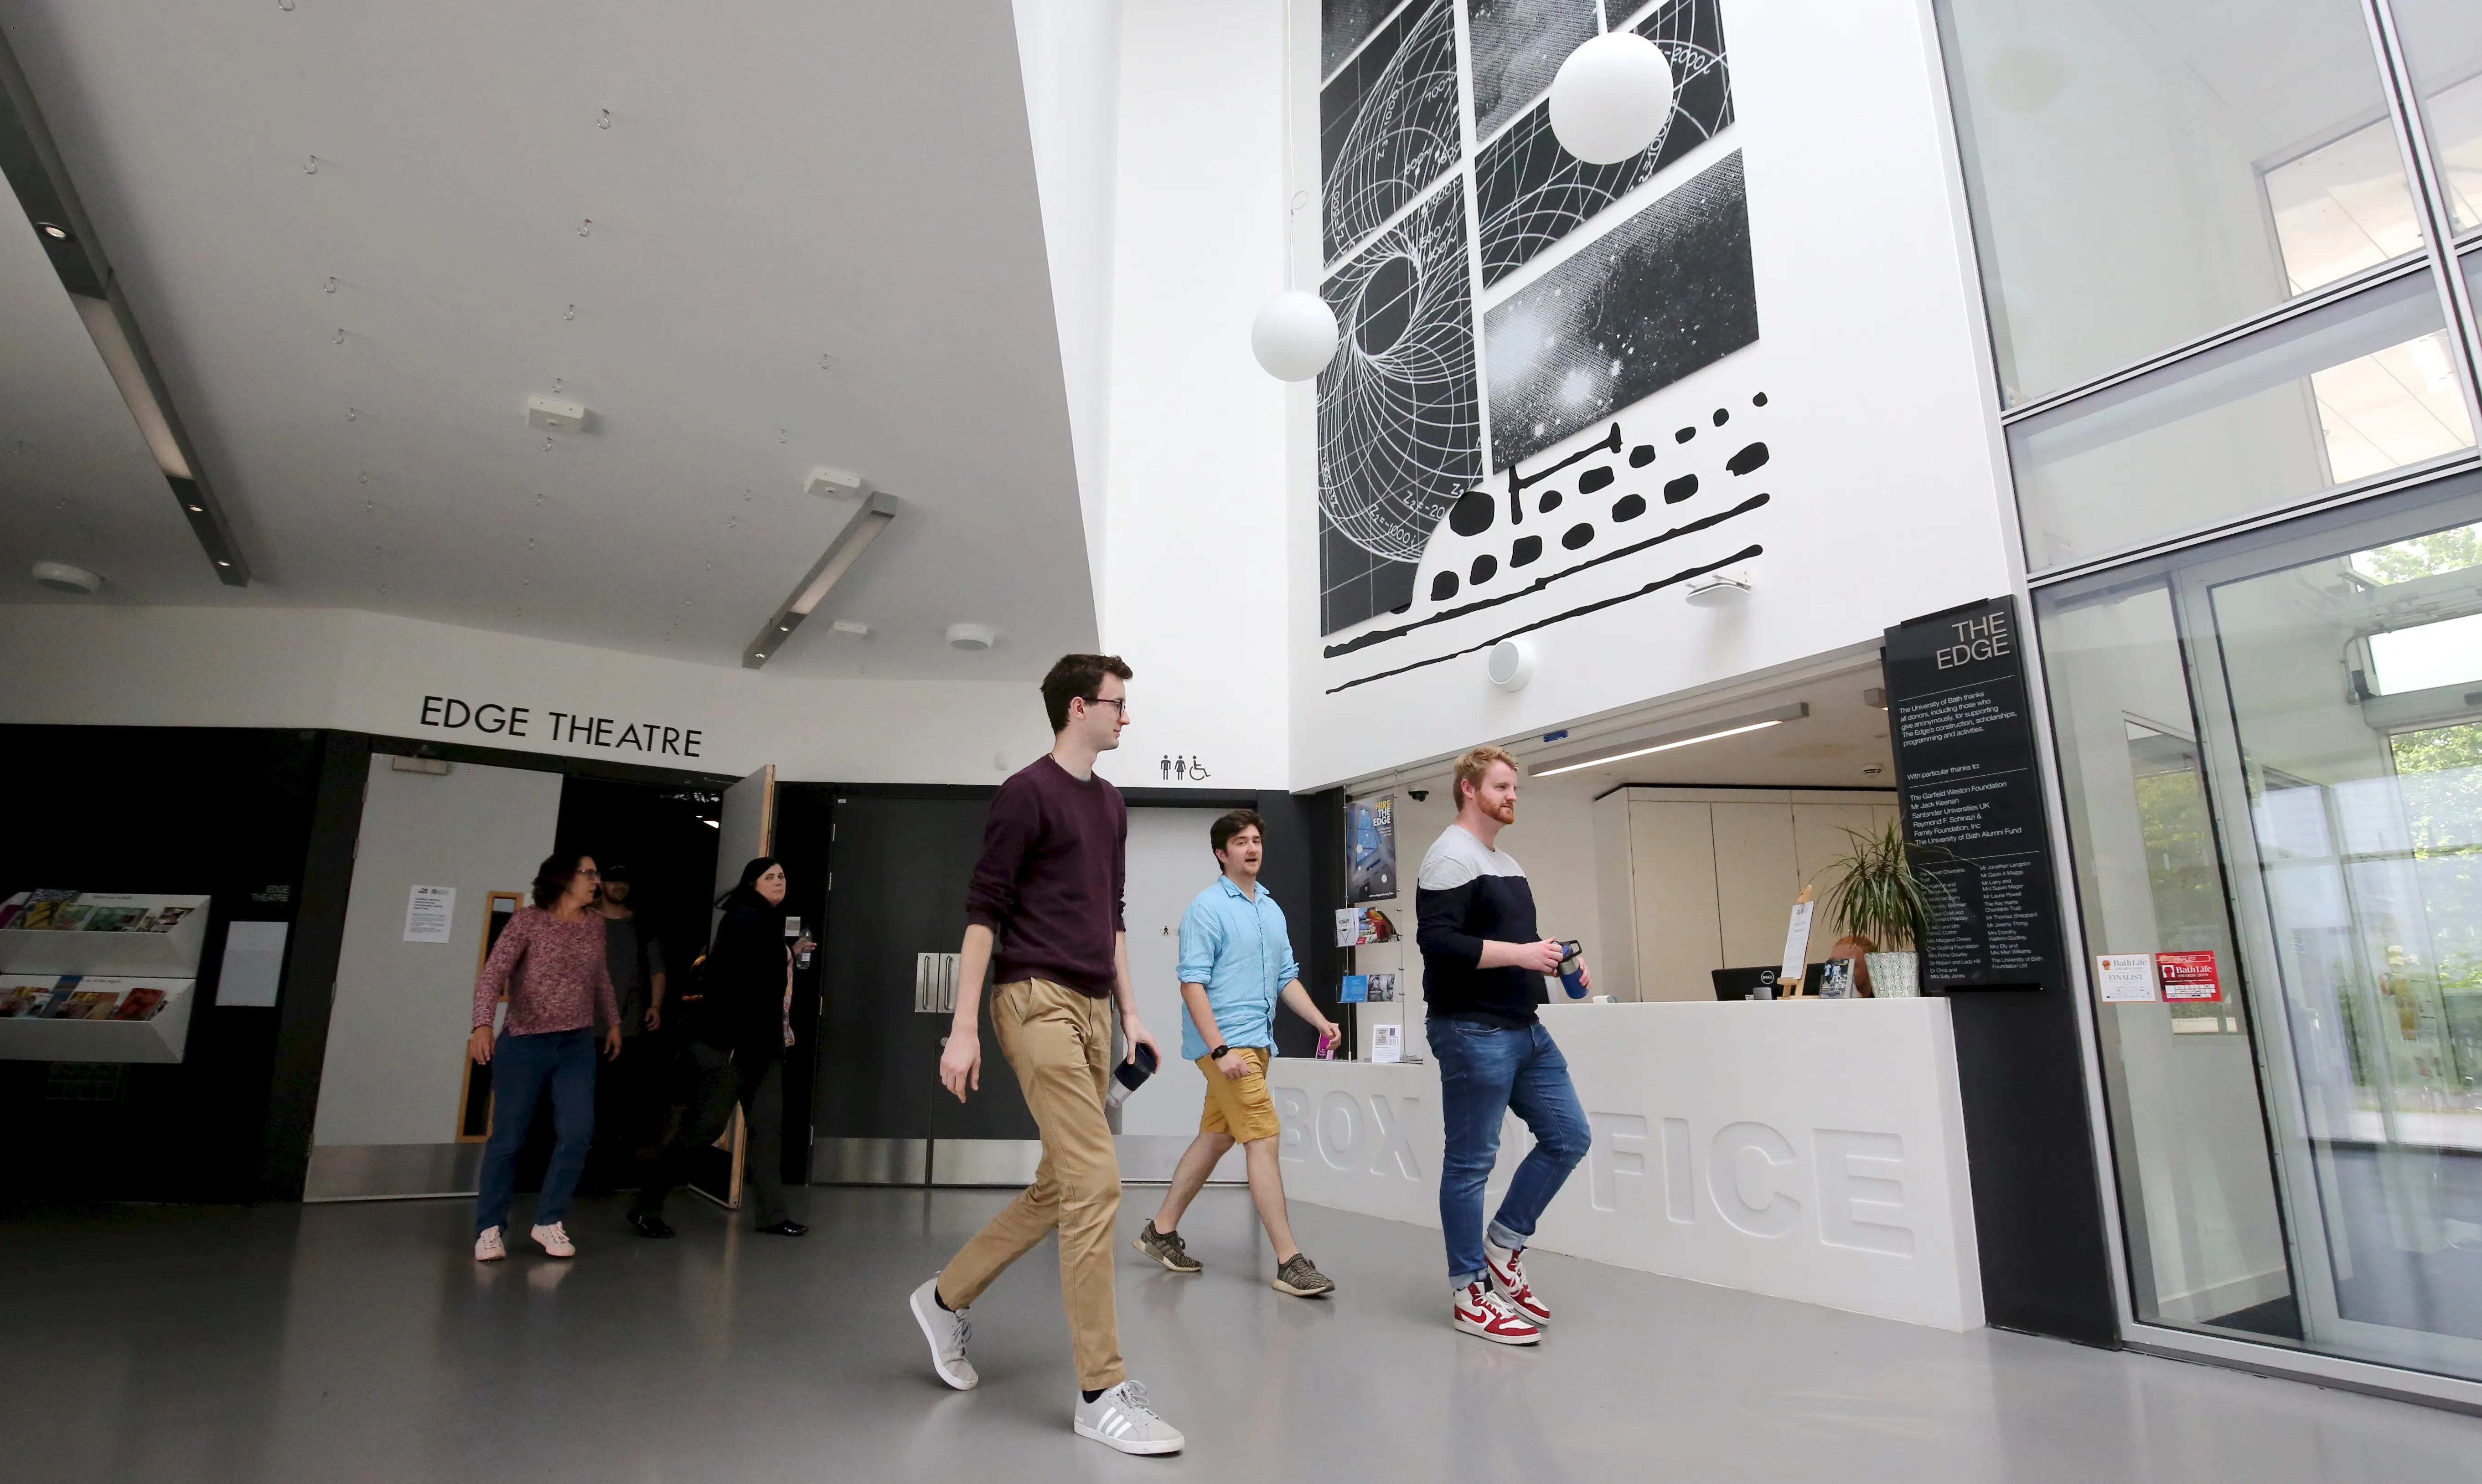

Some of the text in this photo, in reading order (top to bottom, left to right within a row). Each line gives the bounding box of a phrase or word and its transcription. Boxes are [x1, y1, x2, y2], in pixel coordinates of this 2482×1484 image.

[1952, 611, 2007, 643] THE
[1936, 634, 2010, 670] EDGE
[1912, 701, 1939, 711] University
[1964, 691, 1984, 700] thanks
[1908, 712, 1929, 721] donors,
[1931, 706, 1957, 715] including
[1914, 716, 1954, 727] anonymously,
[1965, 706, 1998, 717] supporting
[420, 695, 703, 757] EDGE THEATRE
[1935, 720, 1974, 731] construction,
[1903, 735, 1942, 747] programming
[1957, 727, 1984, 736] activities.
[1922, 769, 1949, 778] particular
[1923, 791, 1945, 799] Garfield
[1947, 787, 1970, 795] Weston
[1972, 782, 2006, 792] Foundation
[1375, 800, 1391, 810] HIRE
[1913, 810, 1942, 819] Santander
[1944, 805, 1978, 814] Universities
[1378, 808, 1391, 817] THE
[1373, 816, 1391, 827] EDGE
[1913, 819, 1942, 828] Raymond
[1934, 824, 1970, 834] Foundation,
[1928, 835, 1956, 843] University
[1273, 1087, 1913, 1257] BOX FICE
